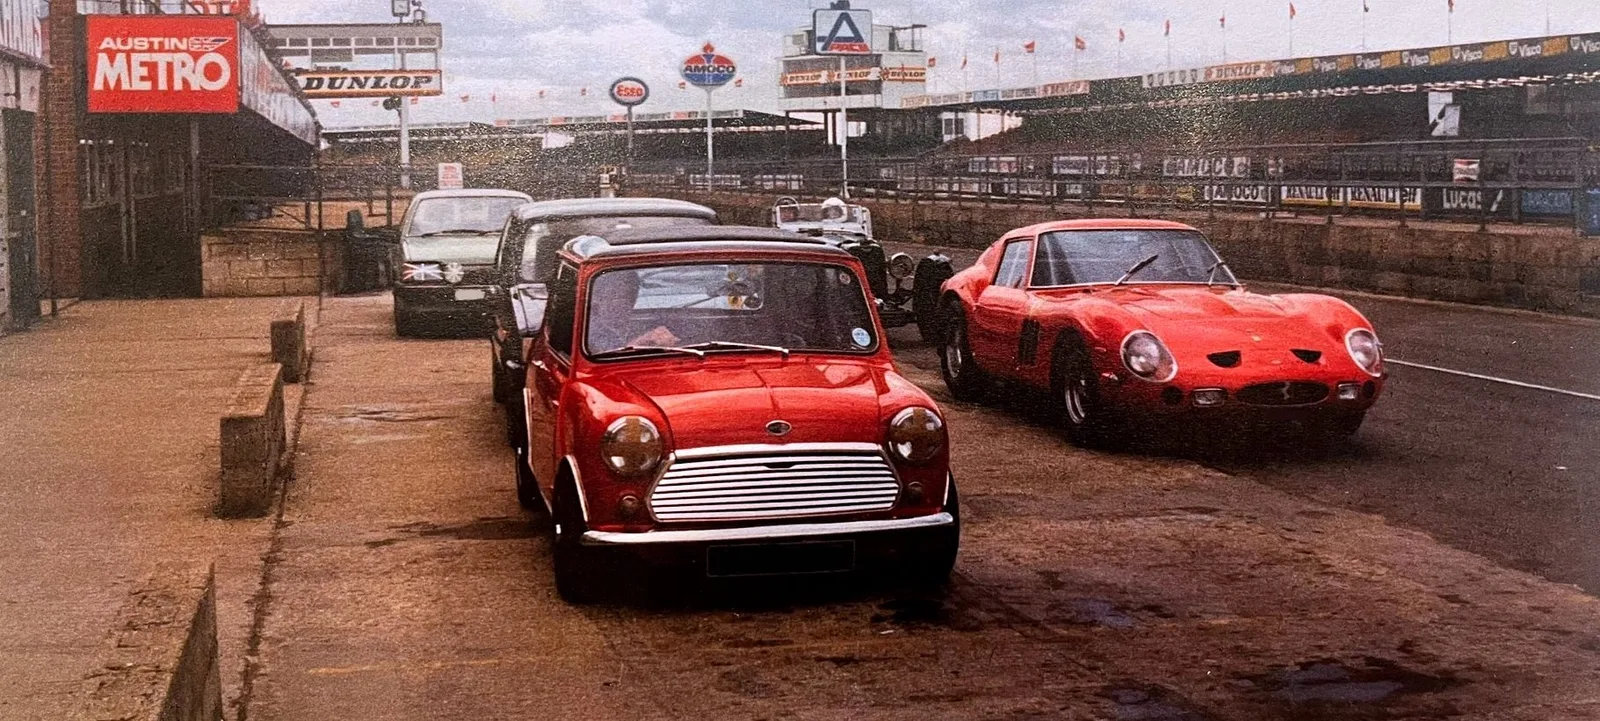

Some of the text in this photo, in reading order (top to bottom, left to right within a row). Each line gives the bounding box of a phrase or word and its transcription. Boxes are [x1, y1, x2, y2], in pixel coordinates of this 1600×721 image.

[98, 37, 189, 50] AUSTIN
[1581, 40, 1600, 53] Visc
[1519, 44, 1542, 57] Visco
[93, 52, 231, 91] METRO
[683, 64, 736, 73] AMOCO
[890, 70, 926, 78] DUNLOP
[1216, 65, 1262, 78] DUNLOP
[302, 75, 433, 90] DUNLOP
[788, 74, 821, 82] DUNLOP
[616, 85, 644, 97] Esso
[1213, 185, 1260, 199] AOCO
